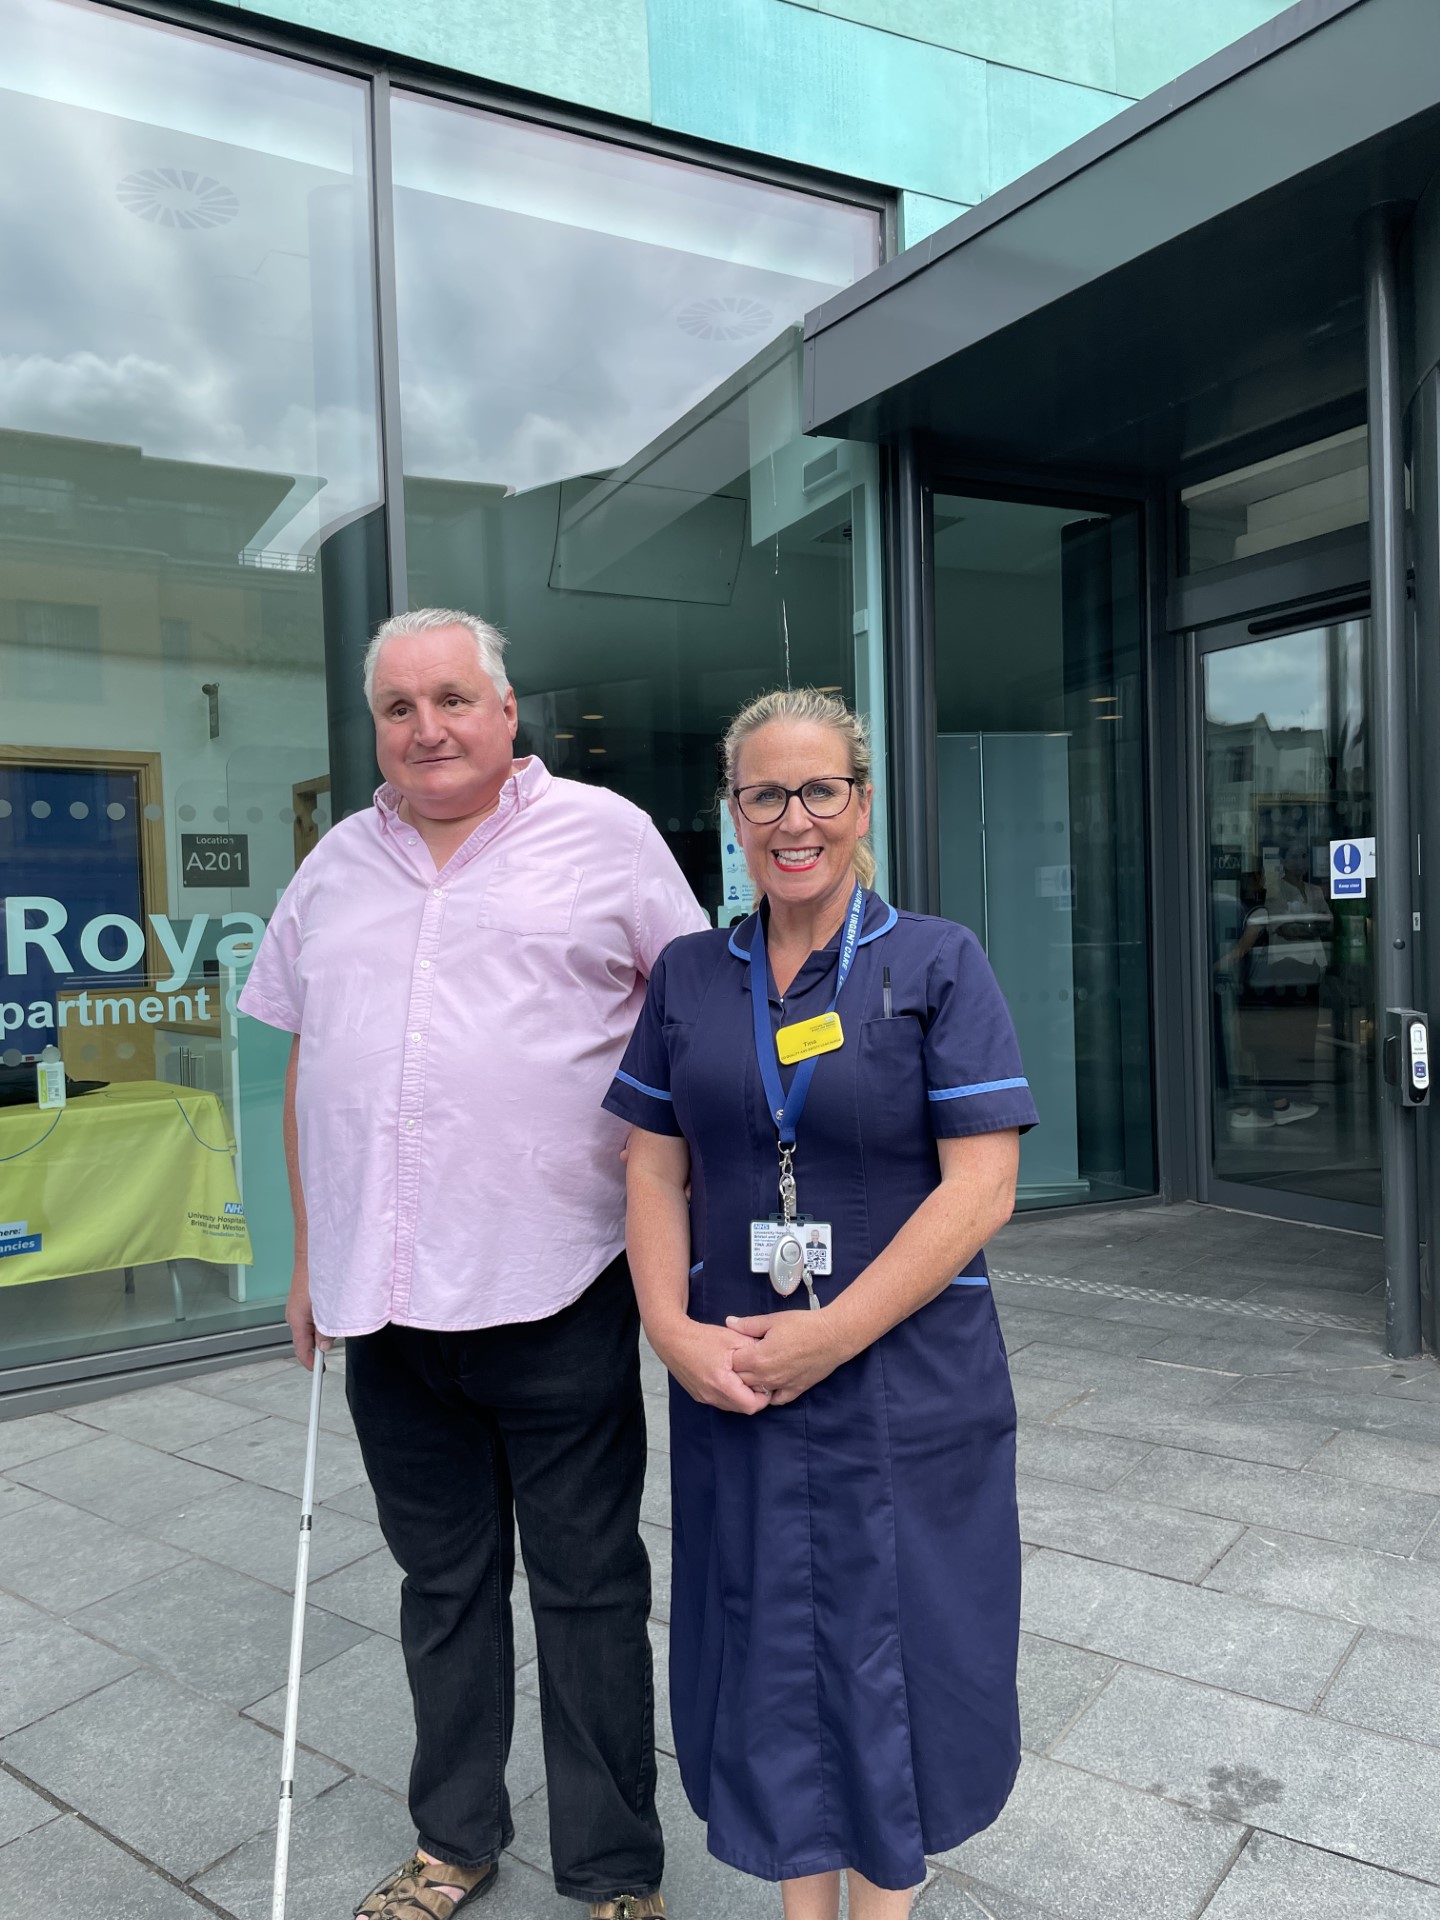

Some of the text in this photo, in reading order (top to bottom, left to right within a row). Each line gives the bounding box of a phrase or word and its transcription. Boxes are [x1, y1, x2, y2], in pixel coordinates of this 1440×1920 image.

[196, 836, 234, 845] Location
[186, 852, 242, 871] A201
[852, 888, 863, 914] NURSE
[5, 889, 281, 993] Roya
[846, 913, 859, 946] URGENT
[841, 946, 852, 971] CARE
[208, 1222, 221, 1230] and
[222, 1223, 246, 1232] Weston
